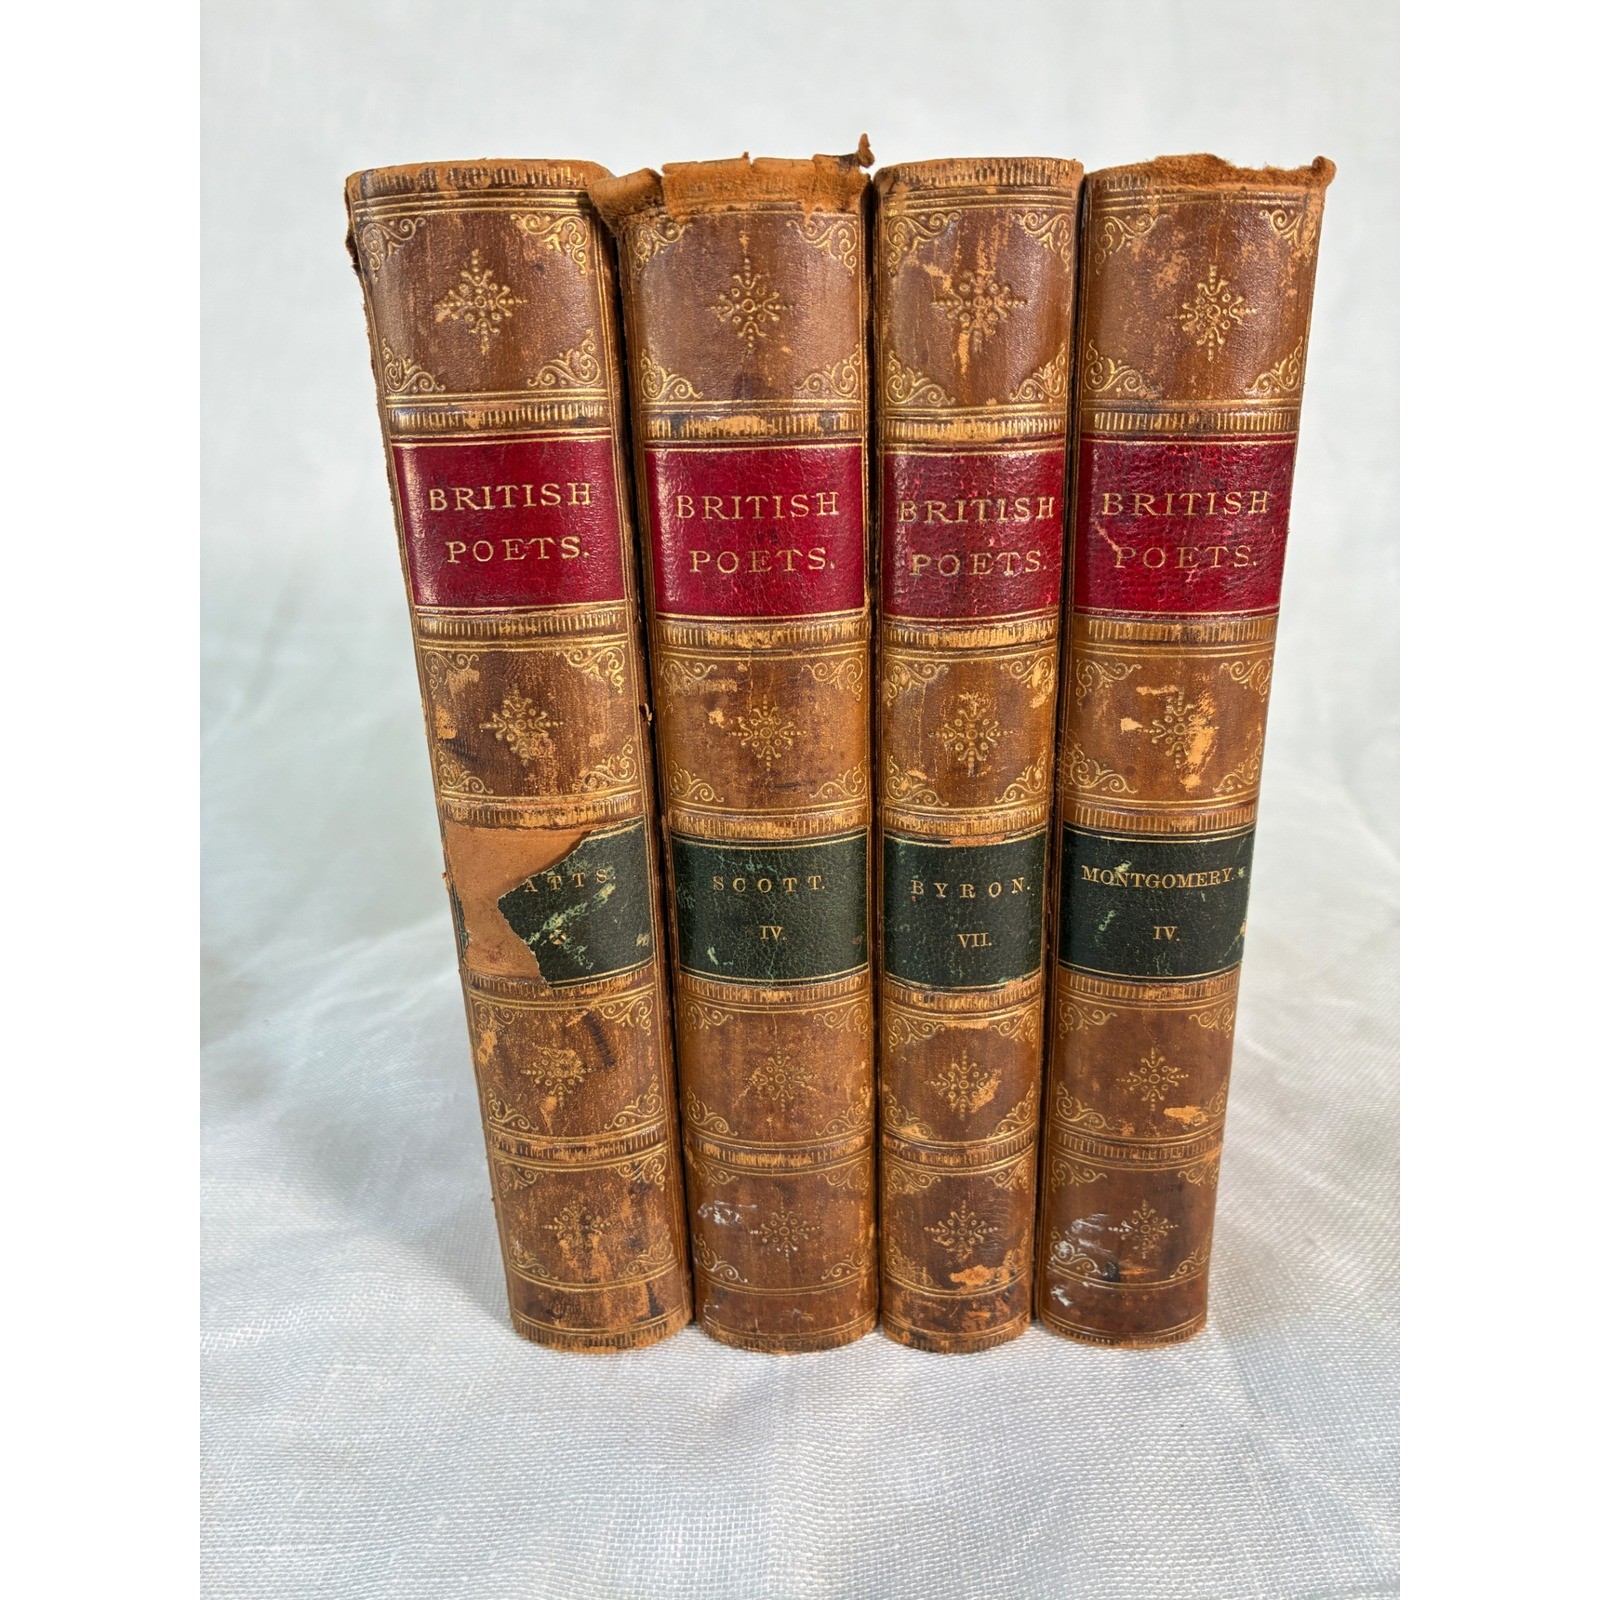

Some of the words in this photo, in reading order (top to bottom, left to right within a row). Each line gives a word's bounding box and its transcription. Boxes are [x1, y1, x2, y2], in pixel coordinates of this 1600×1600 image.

[428, 482, 592, 511] BRITISH
[675, 491, 839, 520] BRITISH
[1101, 490, 1270, 516] BRITISH
[899, 496, 1055, 525] BRITISH
[446, 535, 590, 564] POETS.
[689, 547, 836, 574] POETS.
[1114, 545, 1257, 570] POETS.
[911, 550, 1047, 576] POETS.
[523, 868, 617, 893] ATTS.
[712, 874, 826, 893] SCOTT.
[911, 876, 1031, 898] BYRON.
[1081, 865, 1235, 889] MONTGOMERY.
[760, 925, 788, 941] IV.
[958, 932, 992, 949] VII.
[1153, 926, 1180, 942] IV.
